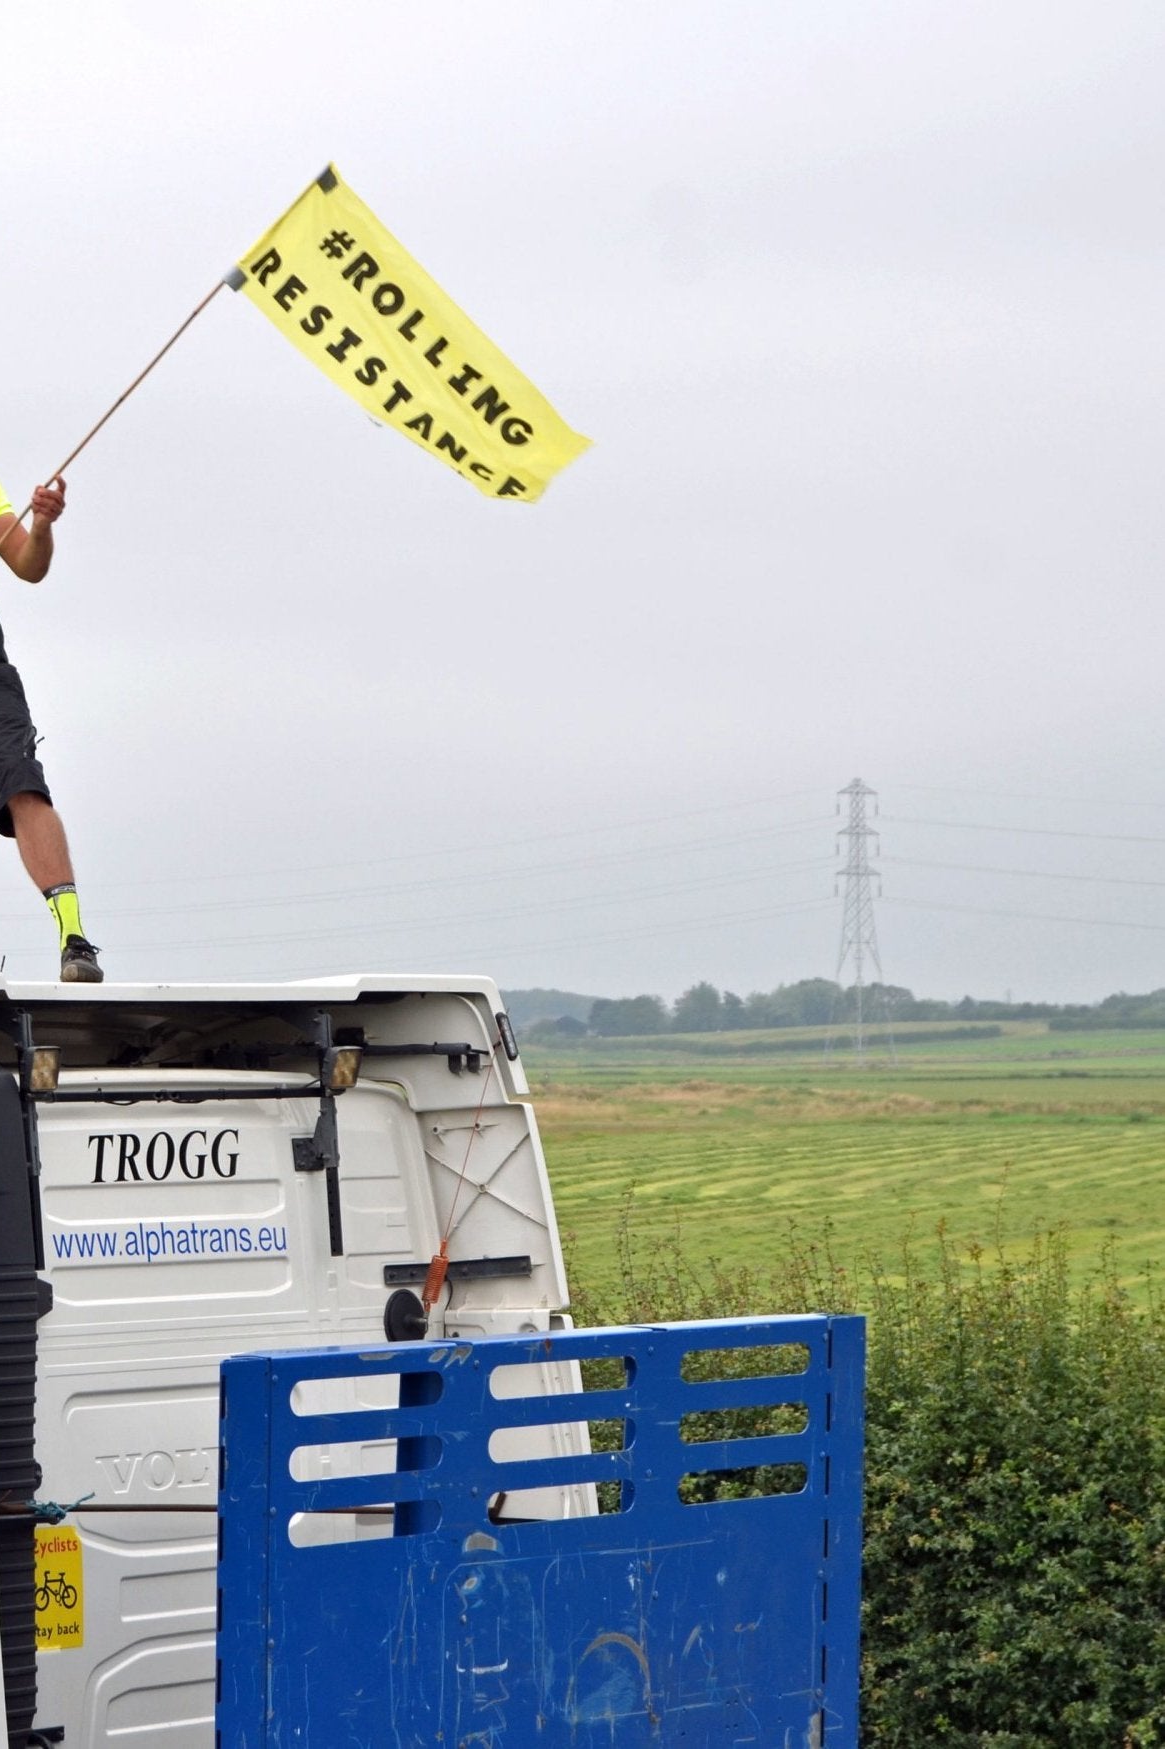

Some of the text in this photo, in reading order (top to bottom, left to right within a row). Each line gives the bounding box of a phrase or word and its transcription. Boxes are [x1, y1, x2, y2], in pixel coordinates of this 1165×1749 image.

[319, 229, 534, 446] #ROLLING
[250, 248, 526, 496] RESISTANCE
[88, 1129, 240, 1183] TROGG
[52, 1222, 288, 1262] www.alphatrans.eu
[36, 1620, 80, 1640] tay back
